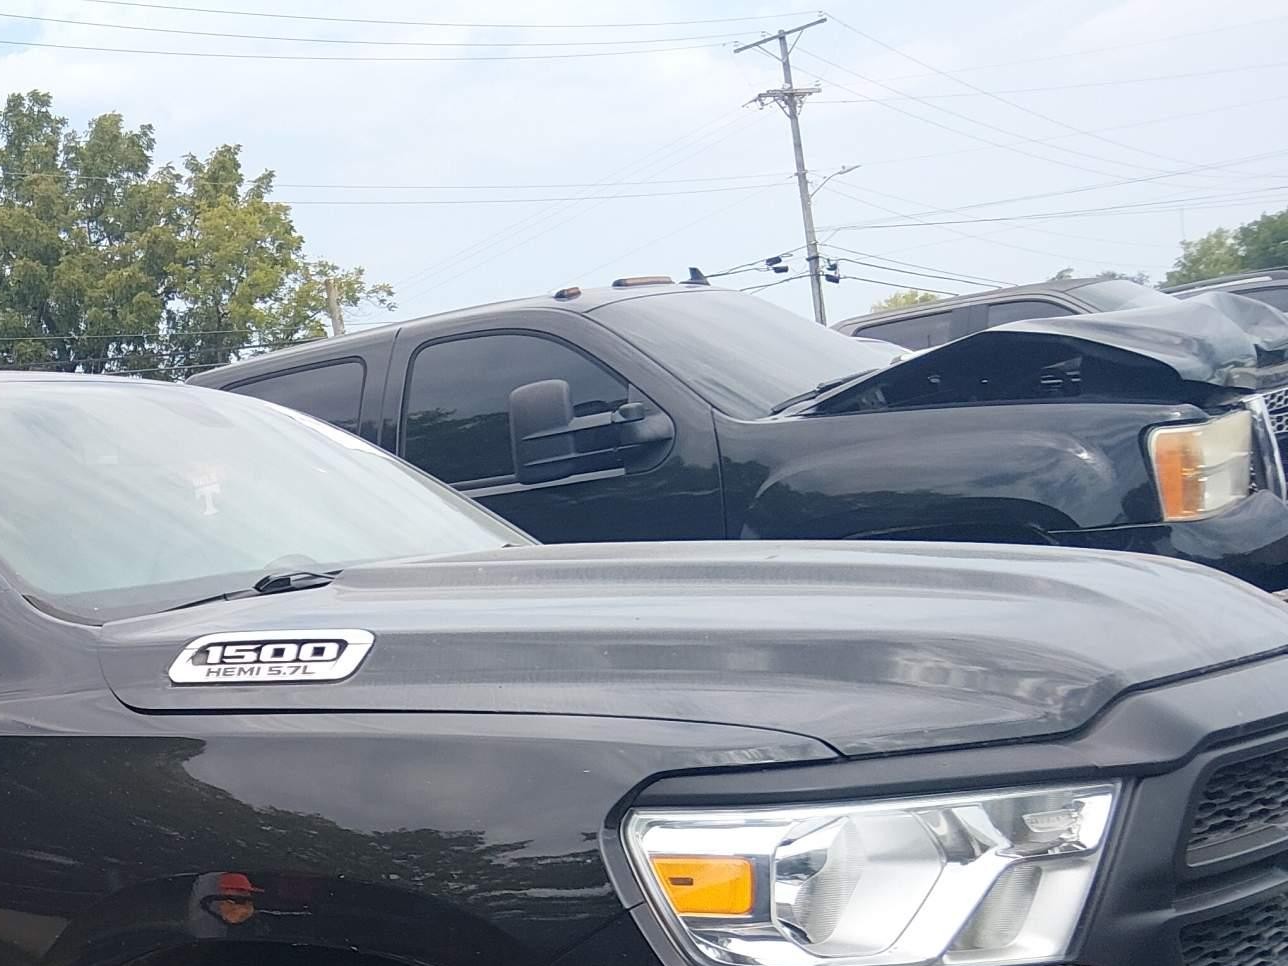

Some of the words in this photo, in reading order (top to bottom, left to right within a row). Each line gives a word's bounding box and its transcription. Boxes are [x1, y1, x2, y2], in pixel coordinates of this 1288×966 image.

[205, 642, 340, 664] 1500
[205, 666, 261, 677] HEMI
[267, 665, 316, 677] 5.7L
